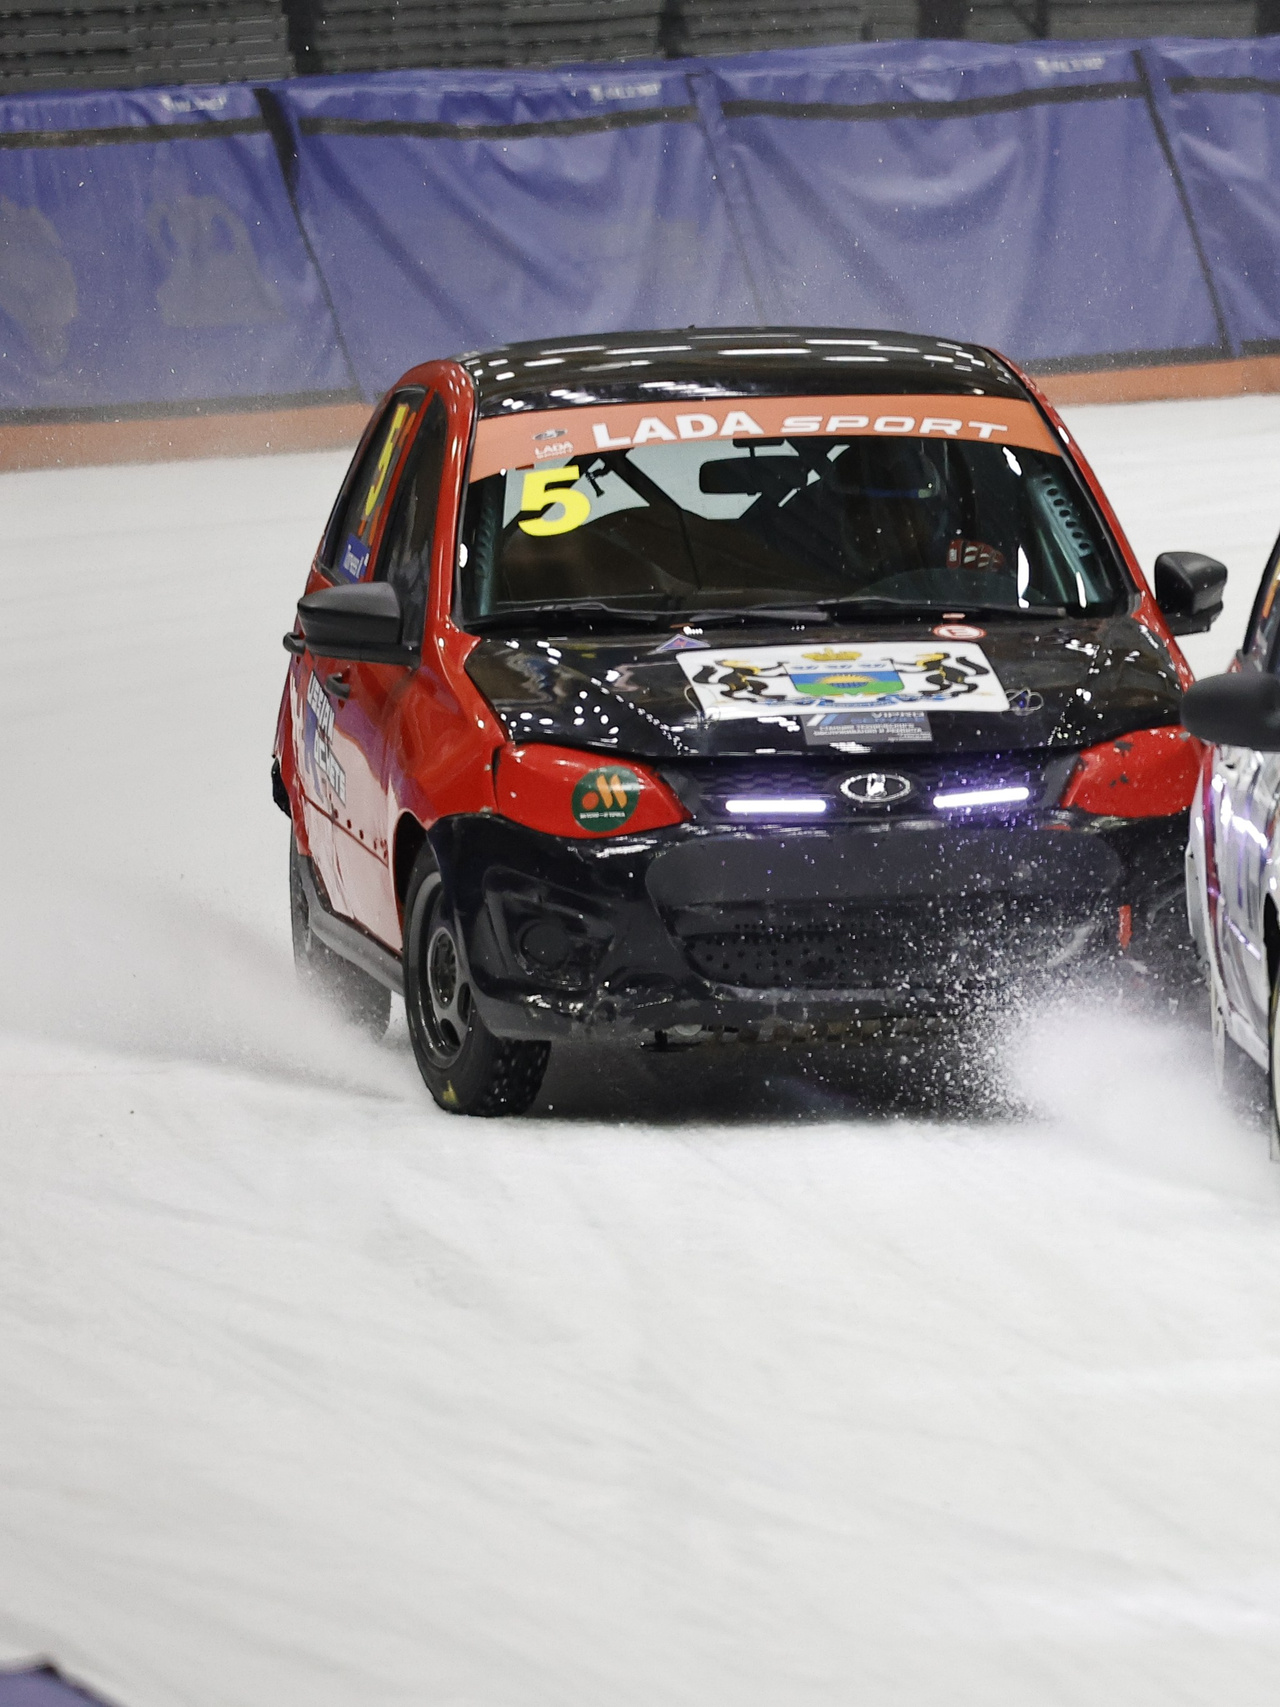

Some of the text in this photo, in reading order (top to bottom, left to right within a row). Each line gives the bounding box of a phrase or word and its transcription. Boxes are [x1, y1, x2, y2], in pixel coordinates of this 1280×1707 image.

[591, 410, 1009, 450] LADA SPORT
[518, 464, 591, 537] 5
